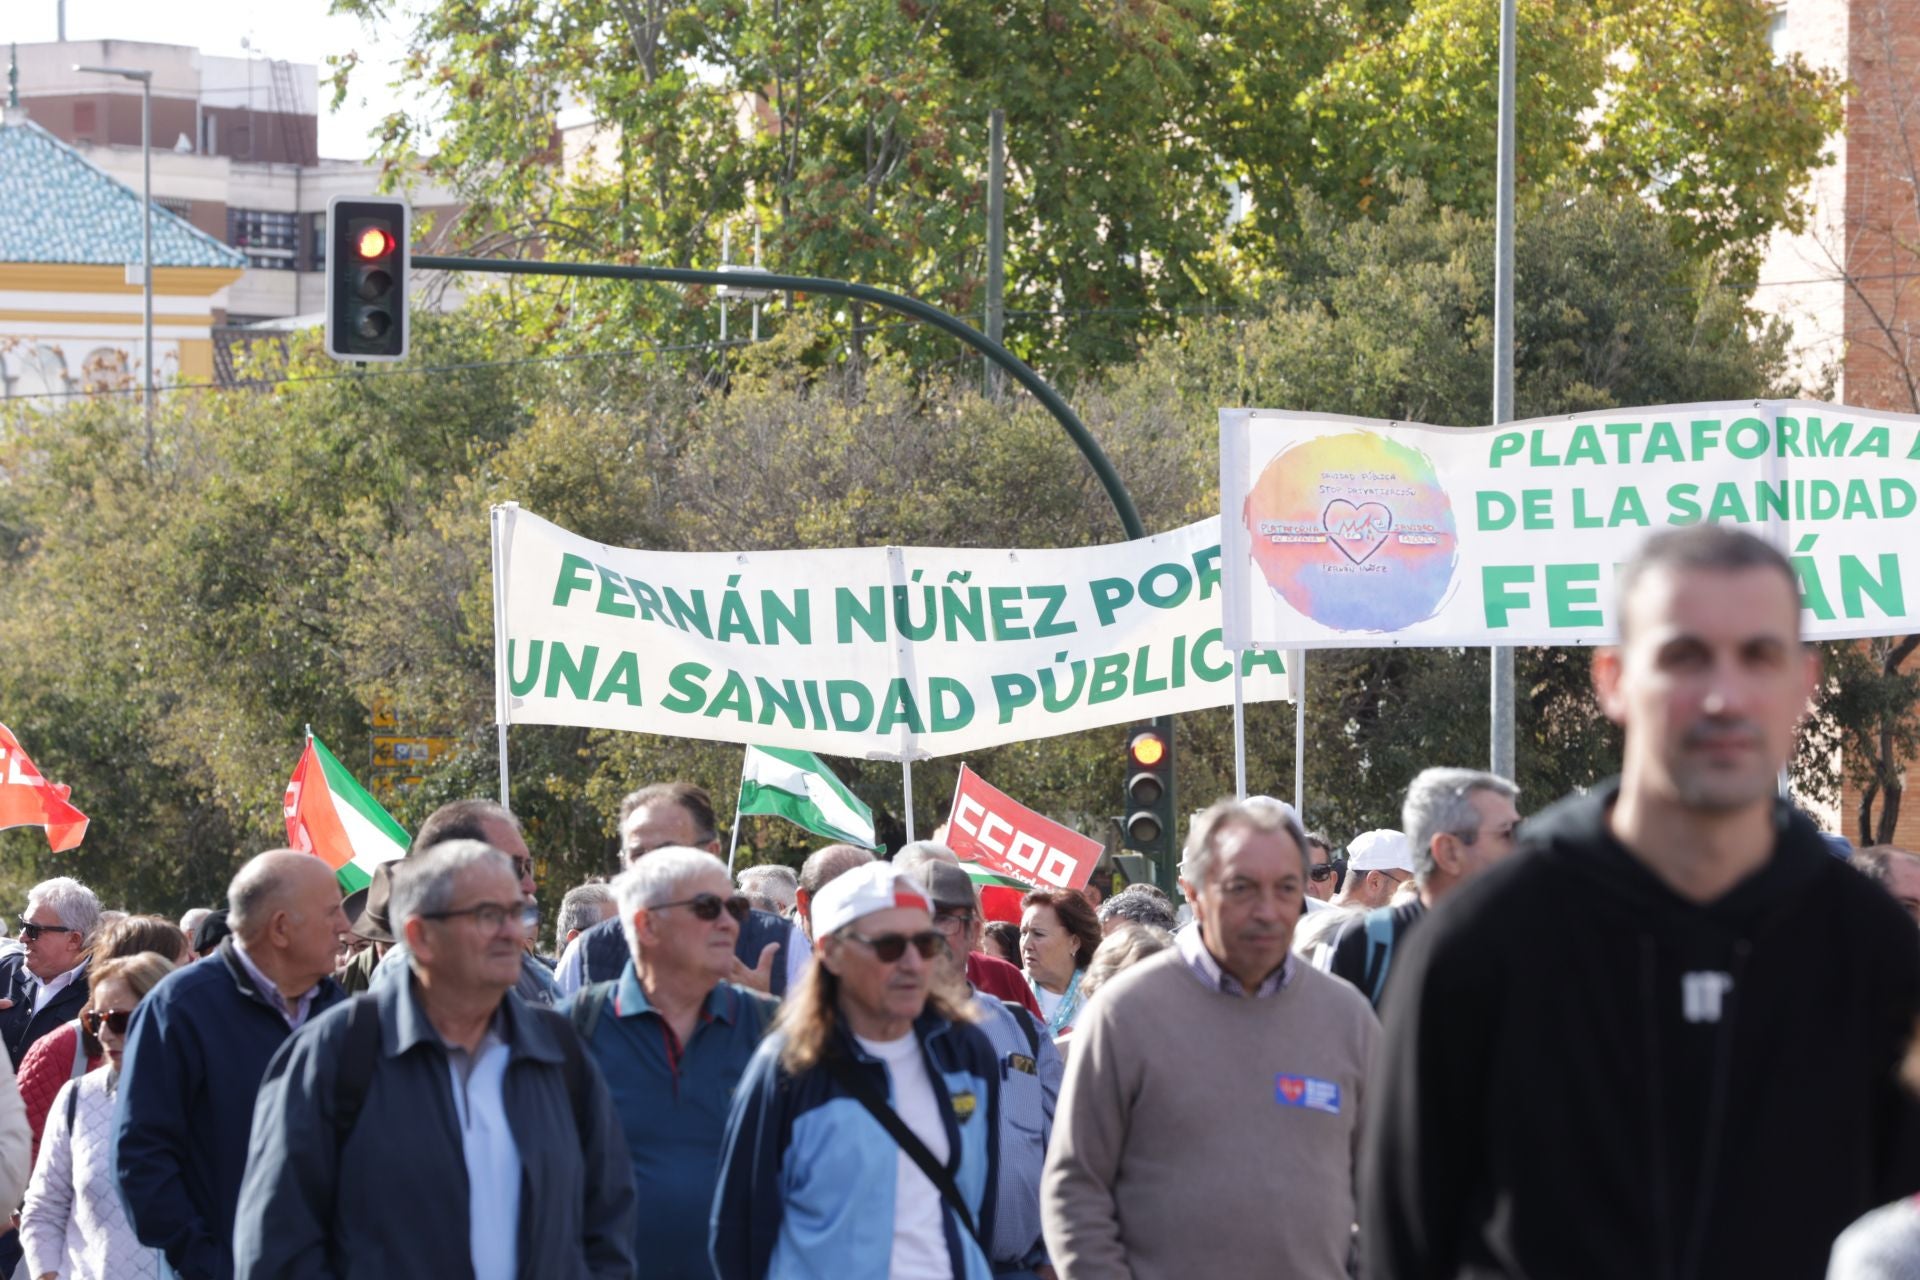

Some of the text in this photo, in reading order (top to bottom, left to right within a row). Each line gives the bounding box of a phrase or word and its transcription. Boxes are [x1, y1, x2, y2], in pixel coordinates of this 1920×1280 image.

[1489, 416, 1890, 468] PLATAFORMA
[1475, 478, 1917, 531] DE LA SANIDAD
[552, 544, 1222, 646] FERNÁN NÚÑEZ POR
[1481, 533, 1906, 629] FEÁN
[508, 638, 643, 707] UNA
[660, 661, 976, 735] SANIDAD
[953, 792, 1079, 888] CCOO
